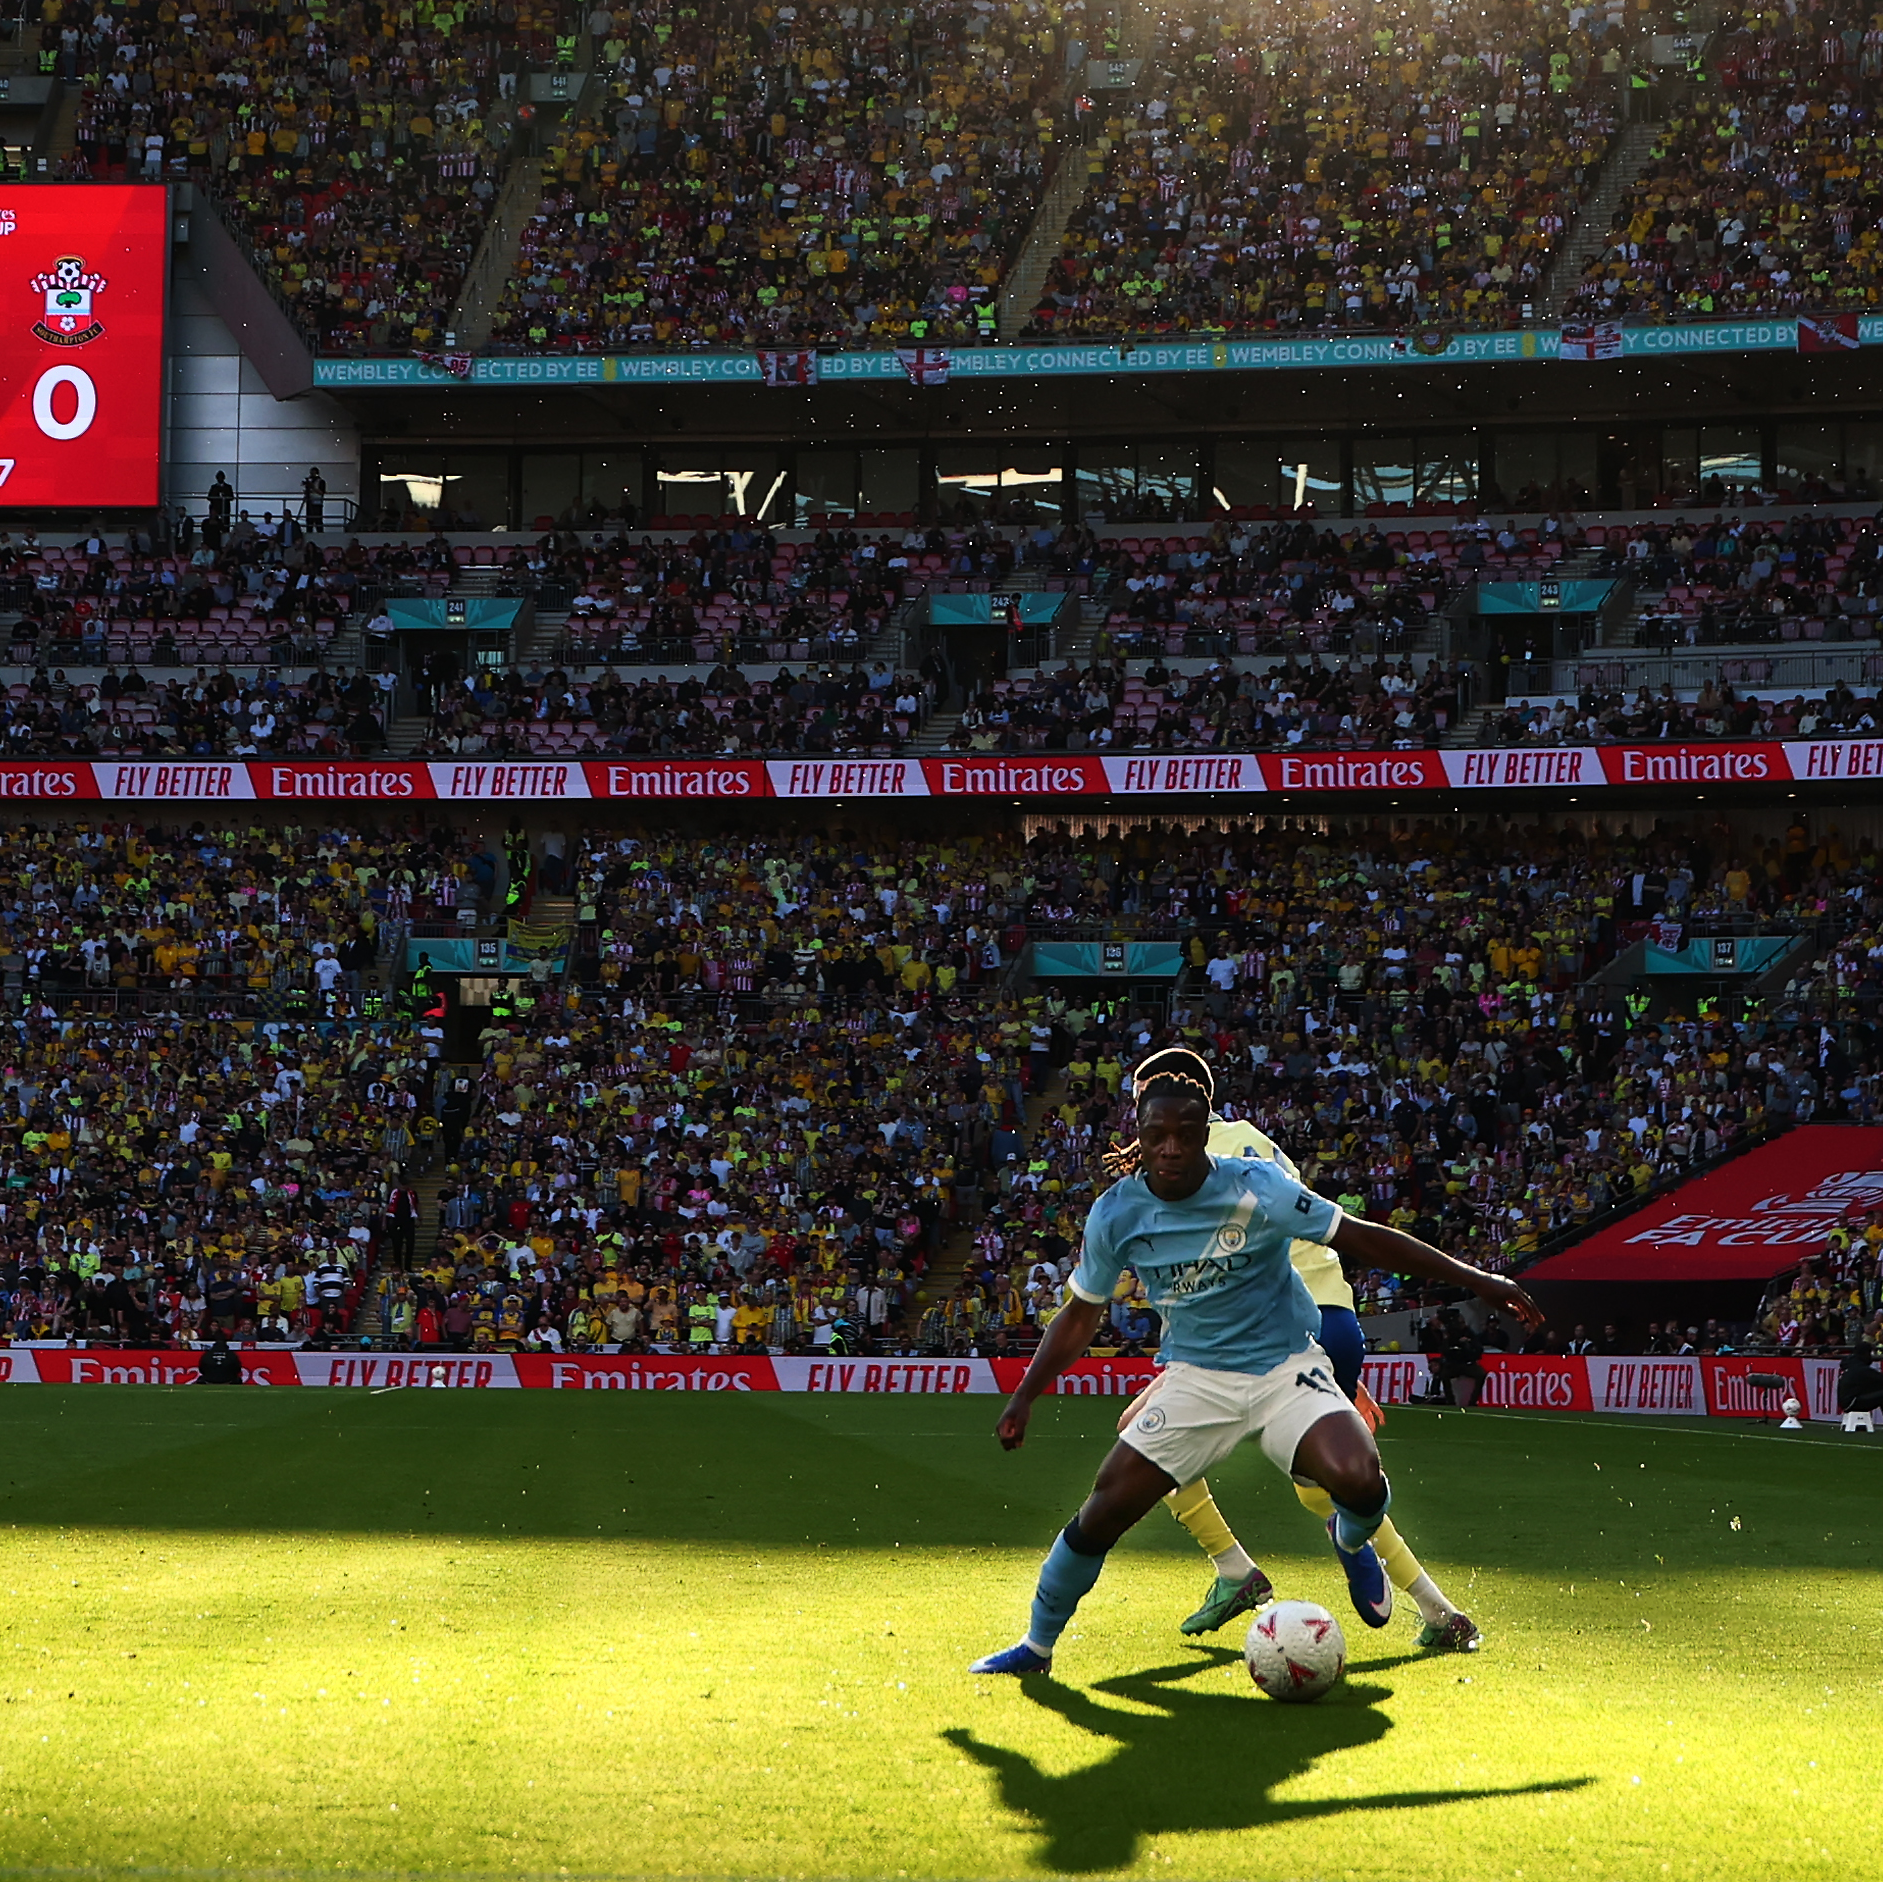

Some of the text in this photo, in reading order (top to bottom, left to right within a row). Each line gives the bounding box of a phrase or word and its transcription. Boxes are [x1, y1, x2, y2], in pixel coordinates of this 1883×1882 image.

[318, 365, 412, 380] WEMBLEY
[547, 363, 572, 377] BY
[577, 362, 597, 377] EE
[622, 360, 716, 376] WEMBLEY
[1186, 349, 1207, 364] EE
[1232, 346, 1328, 362] WEMBLEY
[1644, 327, 1771, 347] CONNECTED
[32, 364, 98, 440] 0
[272, 768, 412, 796] Emirates
[451, 767, 488, 796] FLY
[491, 766, 569, 796] BETTER
[789, 764, 825, 795] FLY
[829, 763, 906, 794] BETTER
[1282, 759, 1423, 787] Emirates
[1463, 753, 1500, 785] FLY
[1504, 752, 1583, 784] BETTER
[480, 943, 496, 953] 135
[1716, 942, 1732, 953] 137
[1623, 1229, 1706, 1246] FA
[1167, 1278, 1227, 1294] RWAYS
[329, 1360, 378, 1386] FLY
[552, 1362, 751, 1392] Emirates
[809, 1364, 856, 1391] FLY
[865, 1364, 971, 1392] BETTER
[1605, 1364, 1636, 1408] FLY
[1638, 1364, 1694, 1408] BETTER
